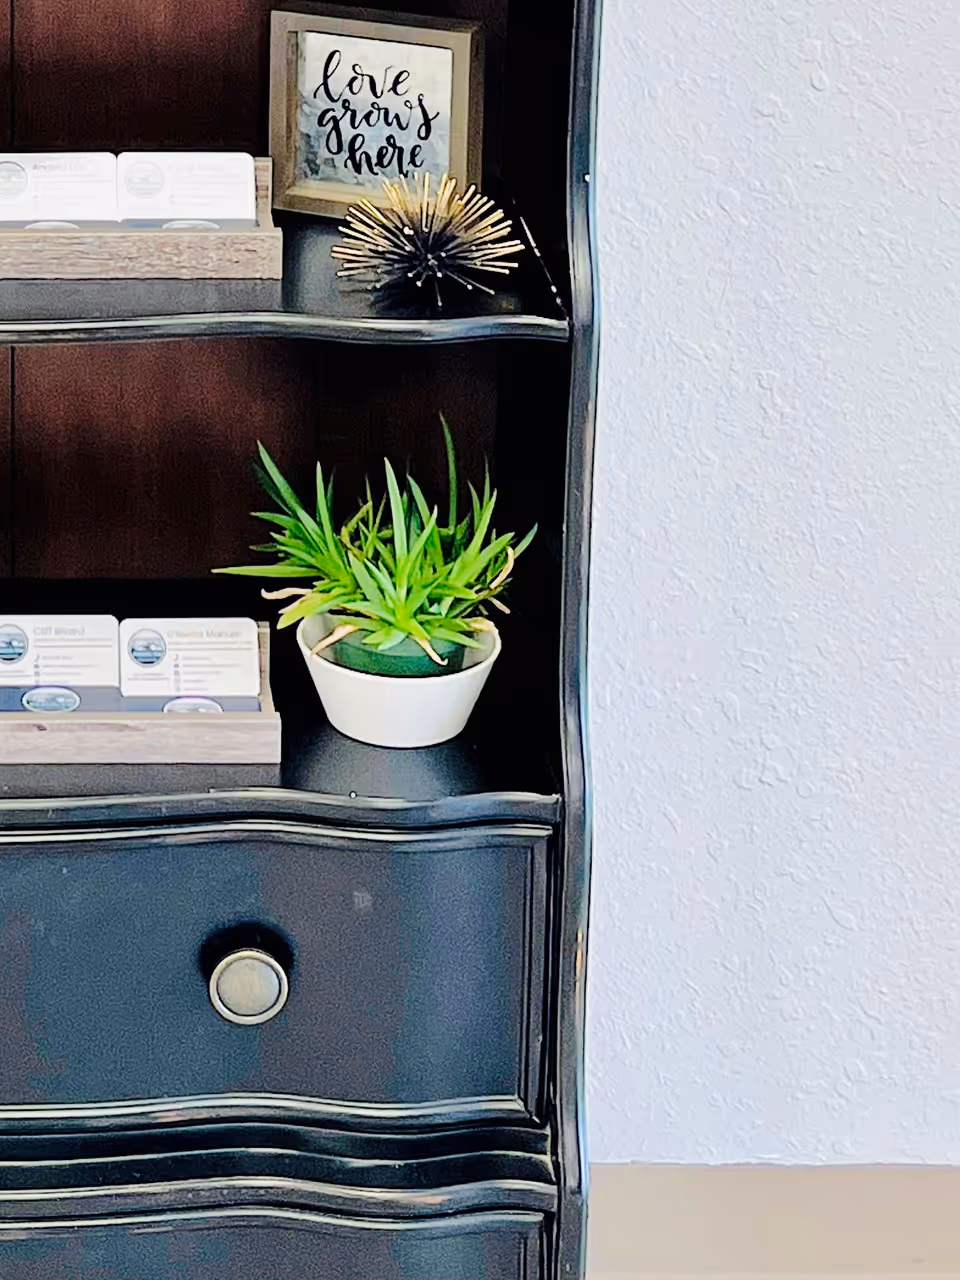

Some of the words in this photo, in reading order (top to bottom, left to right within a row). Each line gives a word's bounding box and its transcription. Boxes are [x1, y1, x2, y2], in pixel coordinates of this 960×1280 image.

[313, 49, 411, 104] love
[317, 93, 440, 156] grows
[344, 133, 425, 178] here
